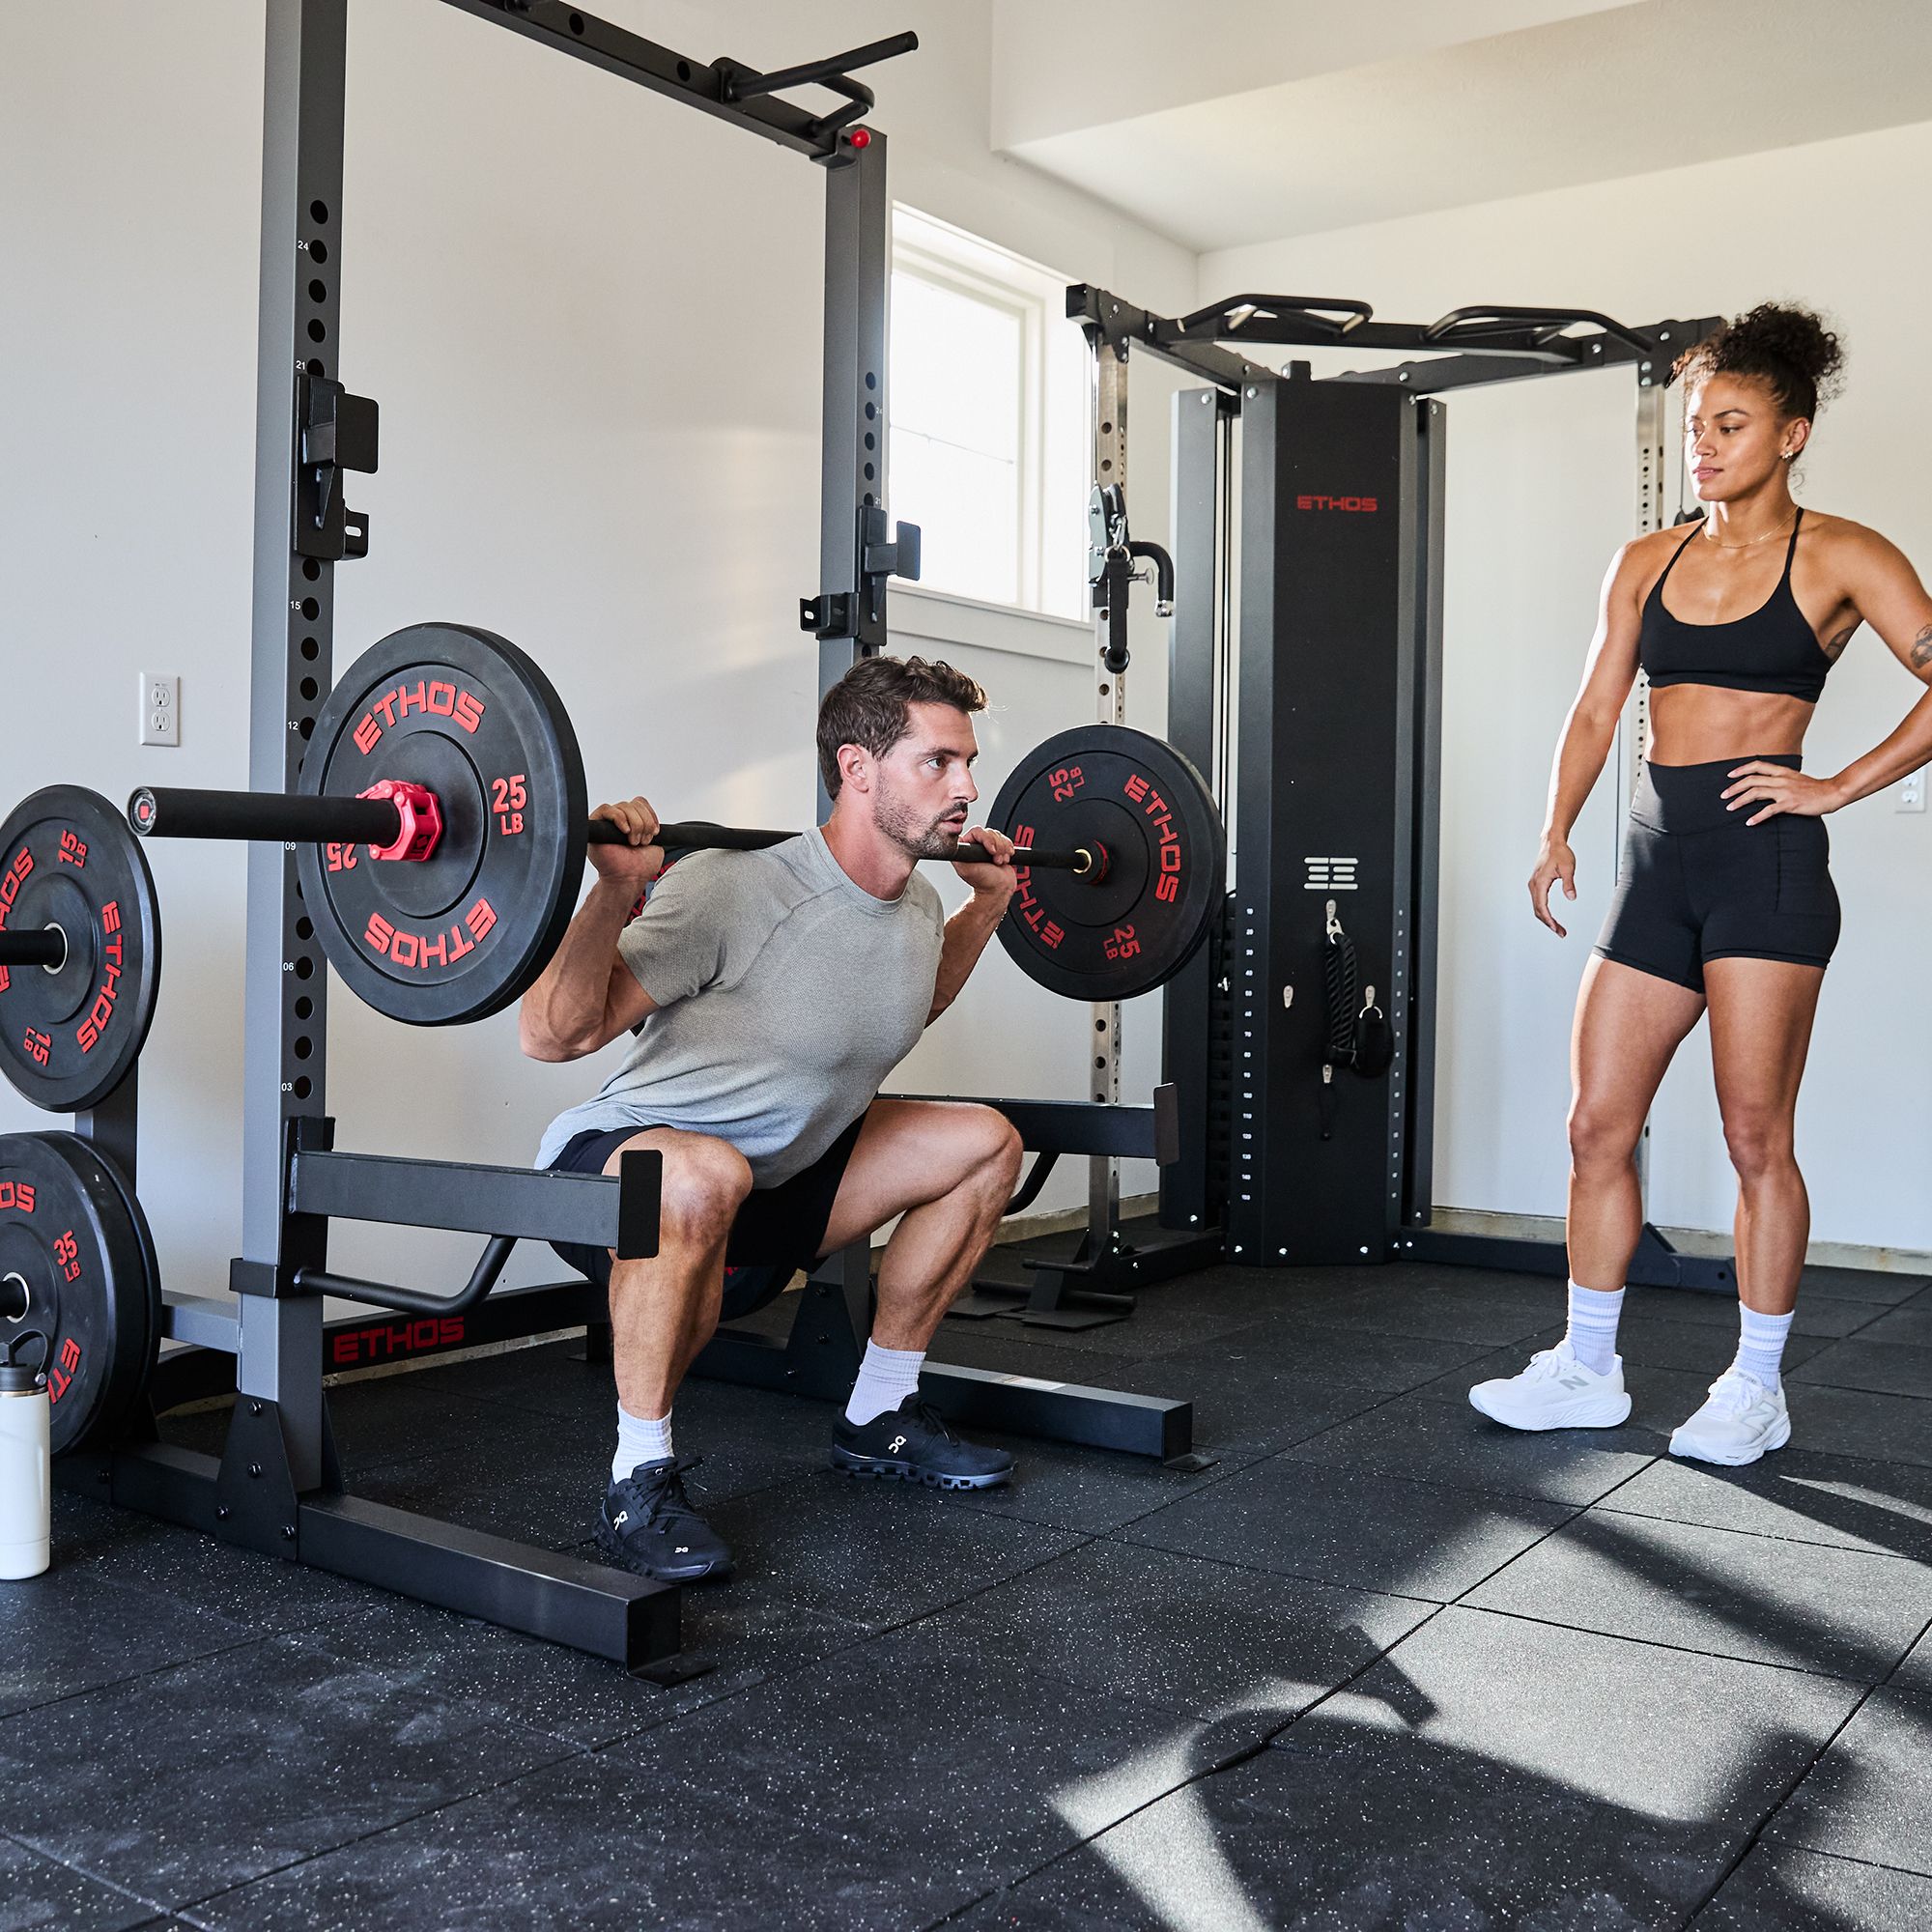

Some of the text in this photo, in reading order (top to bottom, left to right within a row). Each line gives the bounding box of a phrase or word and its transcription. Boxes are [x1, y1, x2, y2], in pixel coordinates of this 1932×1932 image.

[298, 240, 309, 251] 24
[296, 359, 306, 371] 21
[1297, 495, 1378, 513] ETHOS
[290, 600, 301, 611] 15
[287, 721, 298, 731] 12
[353, 680, 486, 755] ETHOS
[1049, 767, 1076, 804] 25
[1069, 765, 1086, 789] LB
[492, 774, 527, 814] 25
[500, 813, 525, 837] LB
[1123, 774, 1182, 904] ETHOS
[58, 829, 79, 865] 15
[74, 840, 89, 869] LB
[284, 841, 297, 851] 09
[363, 897, 498, 969] ETHOS
[1114, 923, 1143, 959] 25
[1103, 937, 1119, 960] LB
[76, 900, 123, 1054] ETHOS
[282, 961, 295, 972] 06
[23, 1026, 37, 1054] LB
[32, 1031, 52, 1067] 15
[280, 1082, 293, 1092] 03
[53, 1230, 79, 1266] 35
[64, 1263, 82, 1283] LB
[333, 1316, 465, 1364] ETHOS
